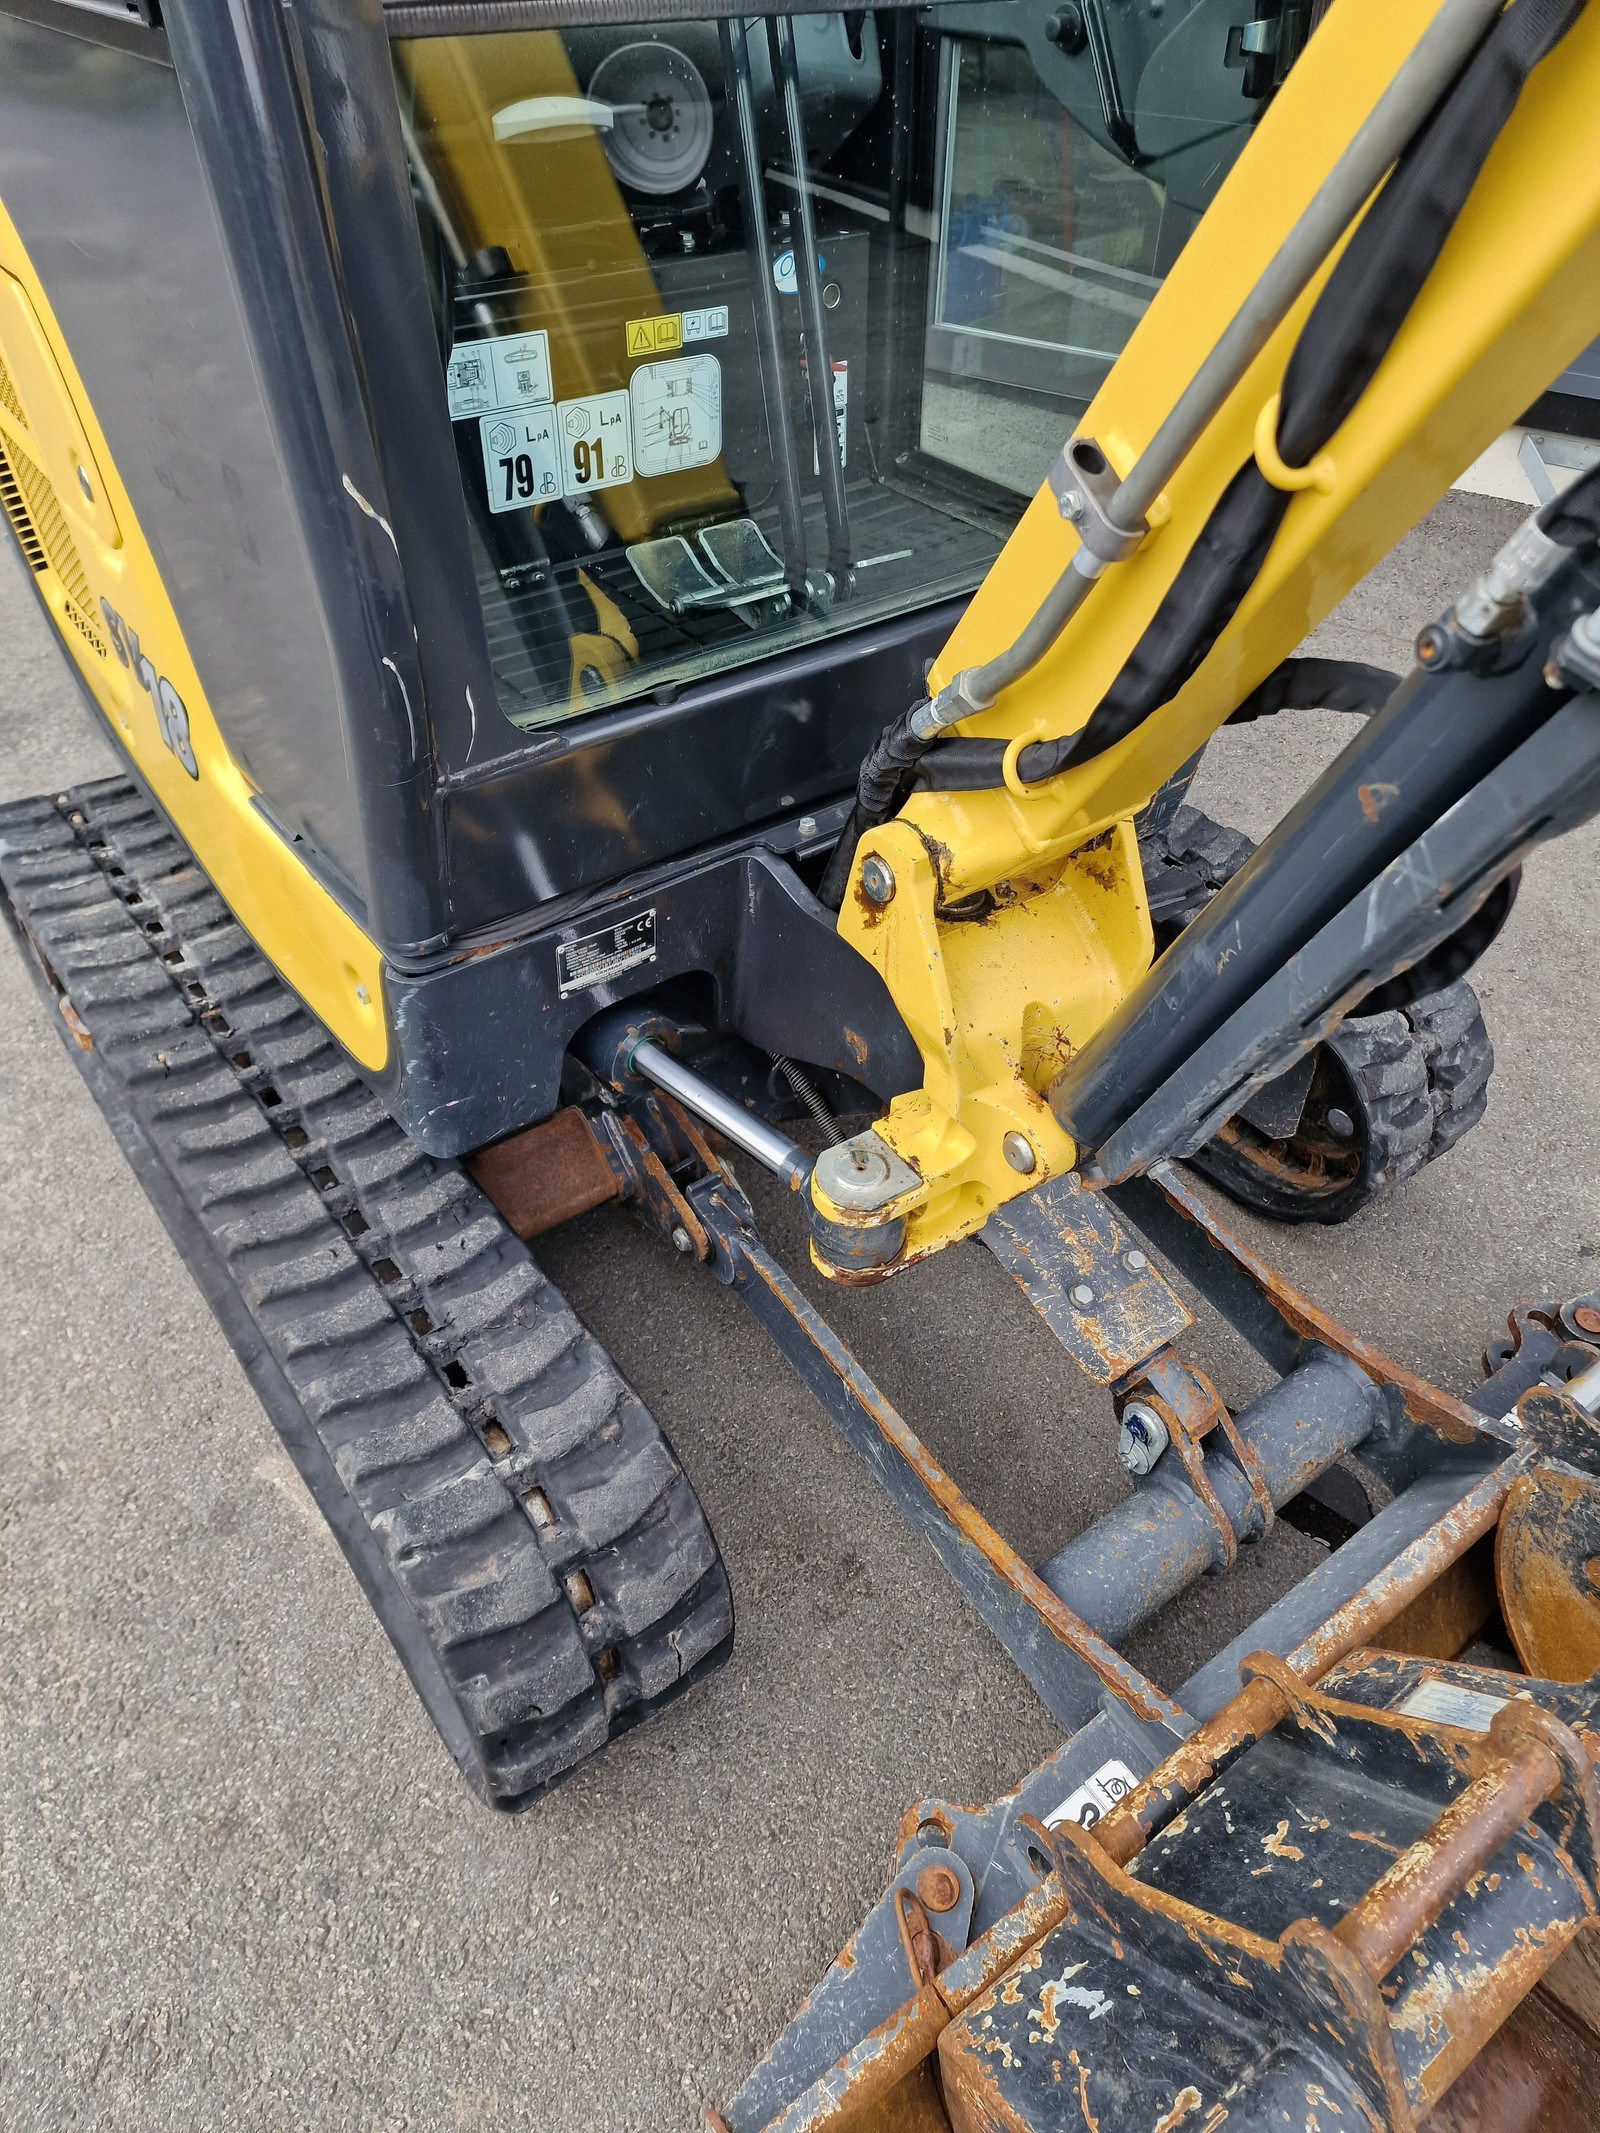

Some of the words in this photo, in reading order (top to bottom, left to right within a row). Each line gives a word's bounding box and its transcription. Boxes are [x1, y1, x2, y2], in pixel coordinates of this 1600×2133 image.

[600, 410, 622, 426] LpA
[525, 426, 549, 443] LpA
[573, 437, 604, 484] 91
[611, 455, 627, 477] dB
[499, 453, 534, 501] 79
[540, 472, 556, 495] dB
[637, 917, 652, 931] CE
